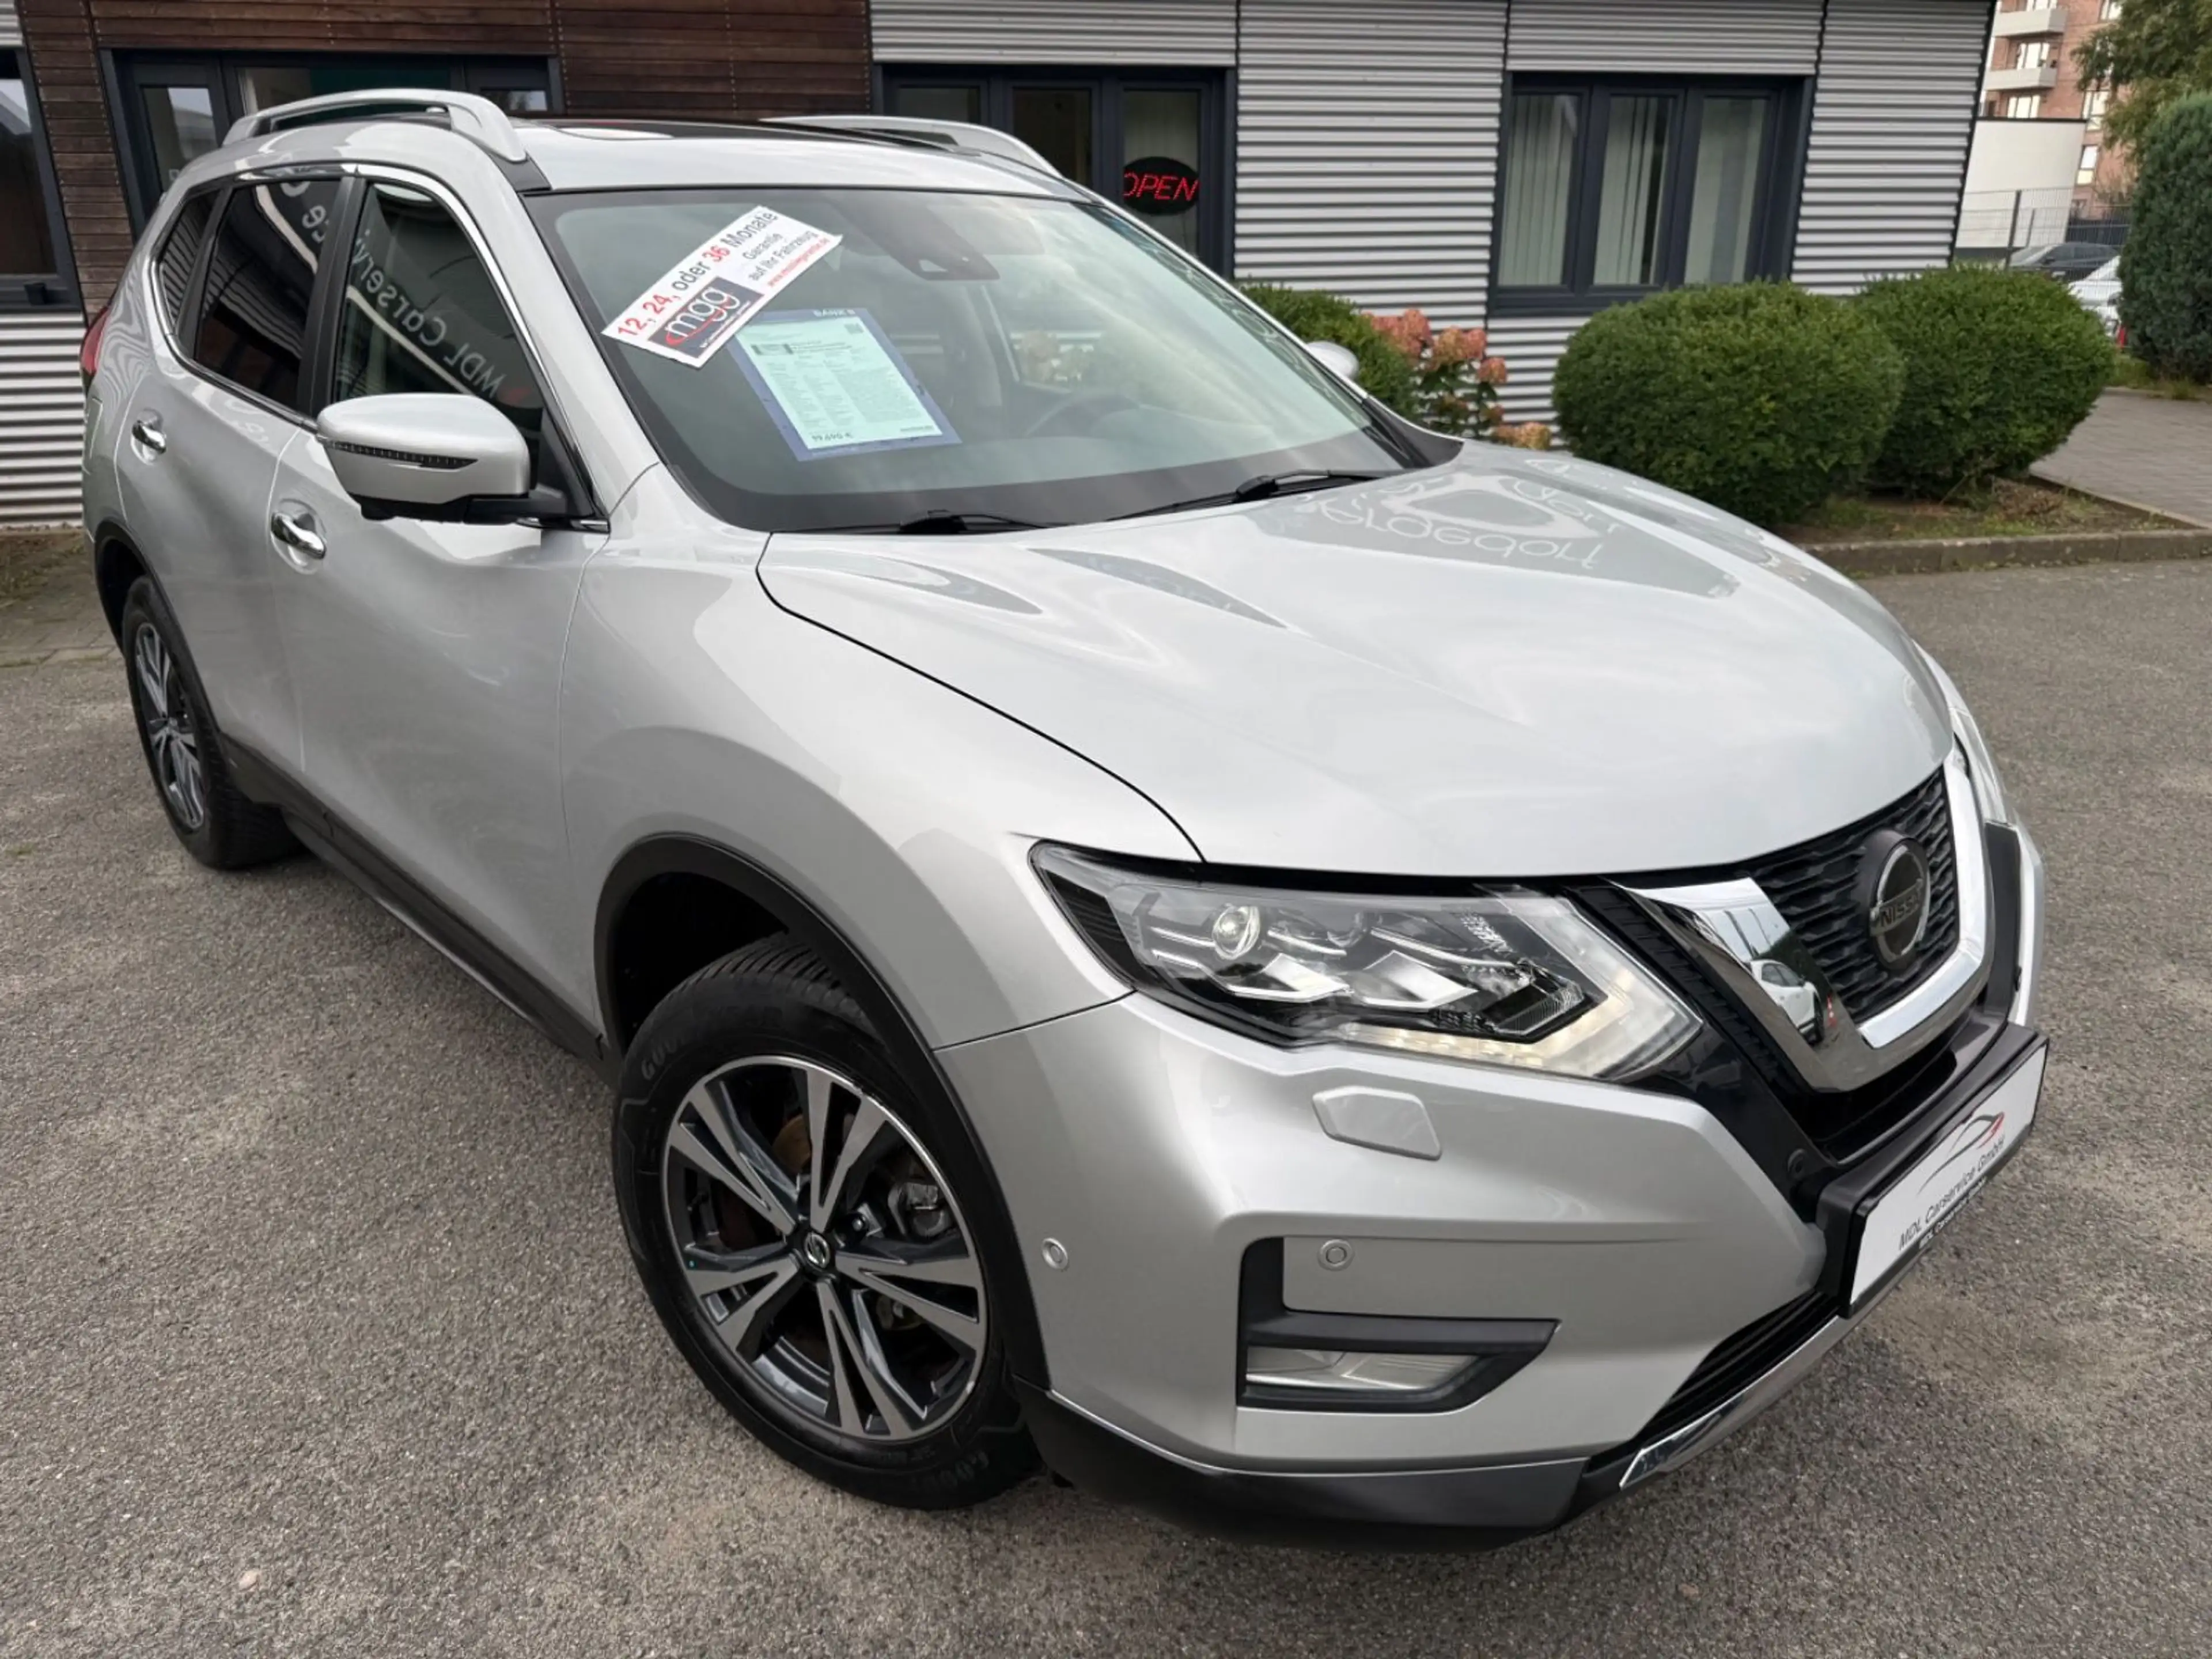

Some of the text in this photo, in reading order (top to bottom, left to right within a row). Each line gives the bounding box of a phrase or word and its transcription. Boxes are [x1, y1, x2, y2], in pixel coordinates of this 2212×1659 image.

[1123, 171, 1200, 201] OPEN
[618, 213, 778, 336] 12, 24, oder 36 Monate
[664, 287, 740, 337] mgg
